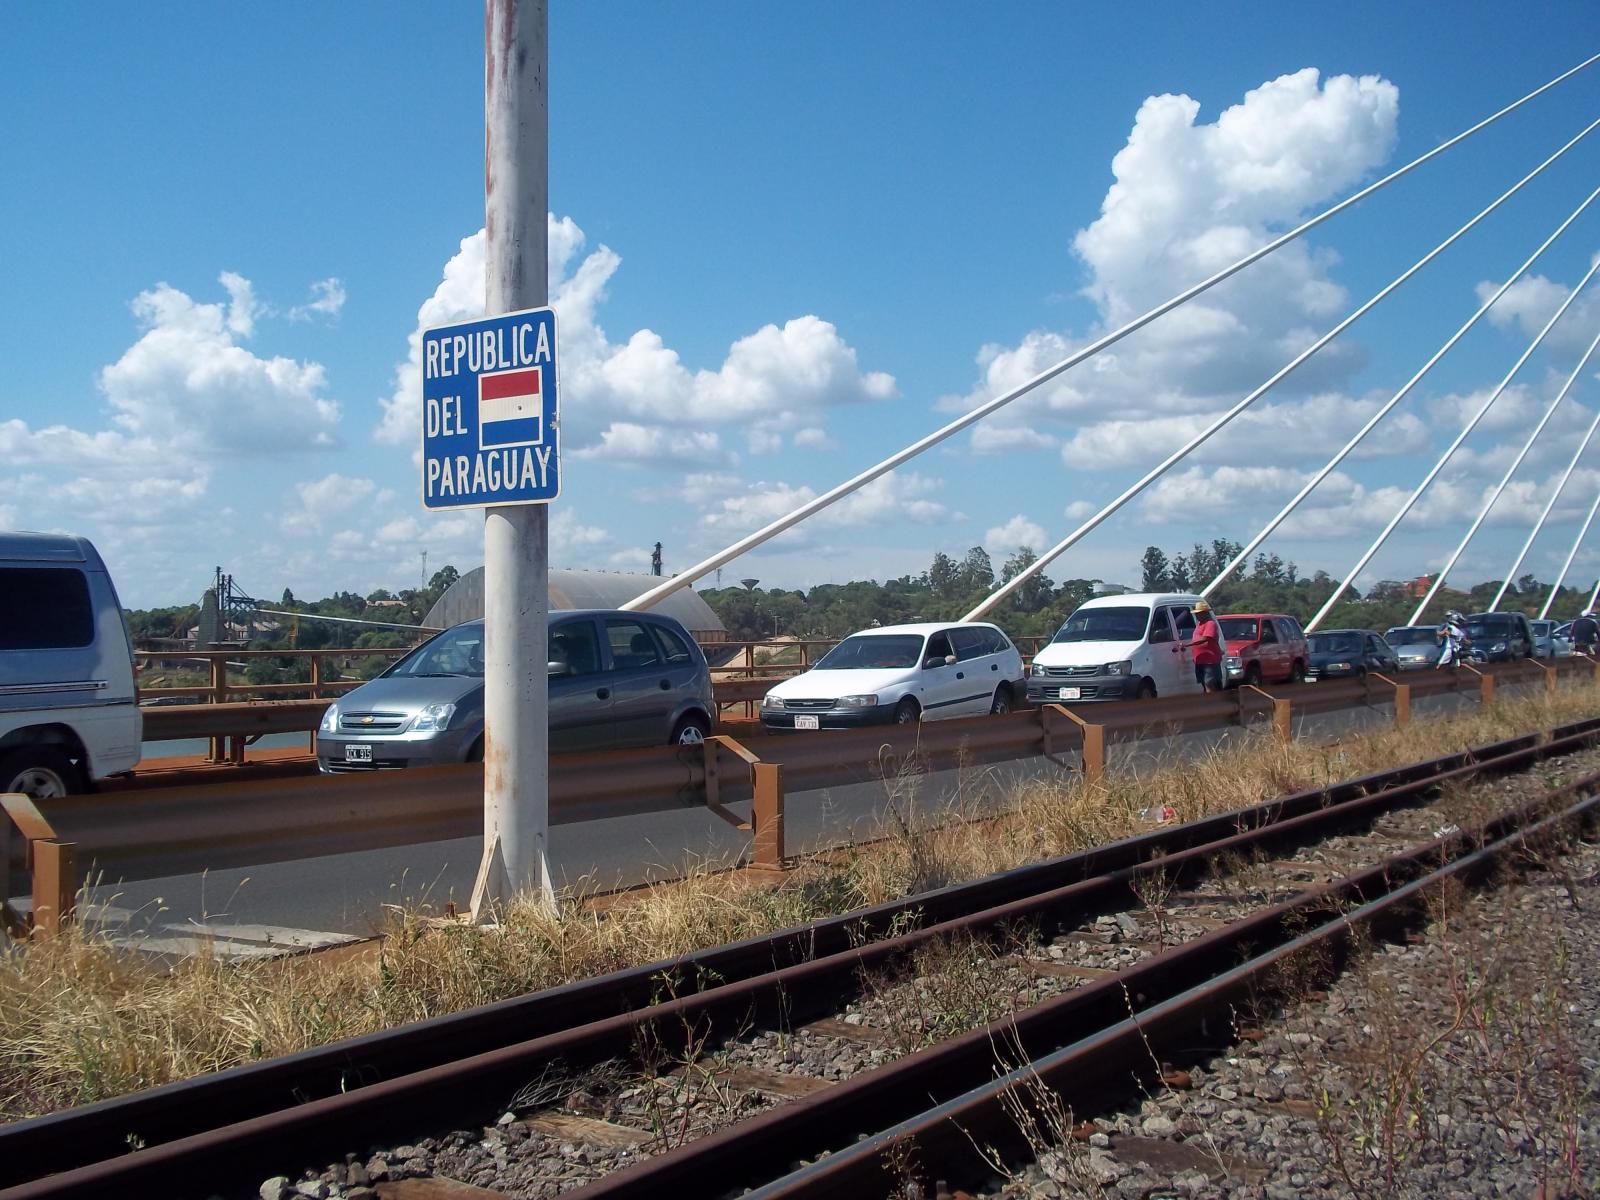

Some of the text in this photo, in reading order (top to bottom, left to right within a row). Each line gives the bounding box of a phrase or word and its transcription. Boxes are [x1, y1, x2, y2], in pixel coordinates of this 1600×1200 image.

[427, 322, 551, 379] REPUBLICA
[427, 395, 468, 438] DEL
[427, 446, 552, 497] PARAGUAY
[360, 750, 371, 759] 915
